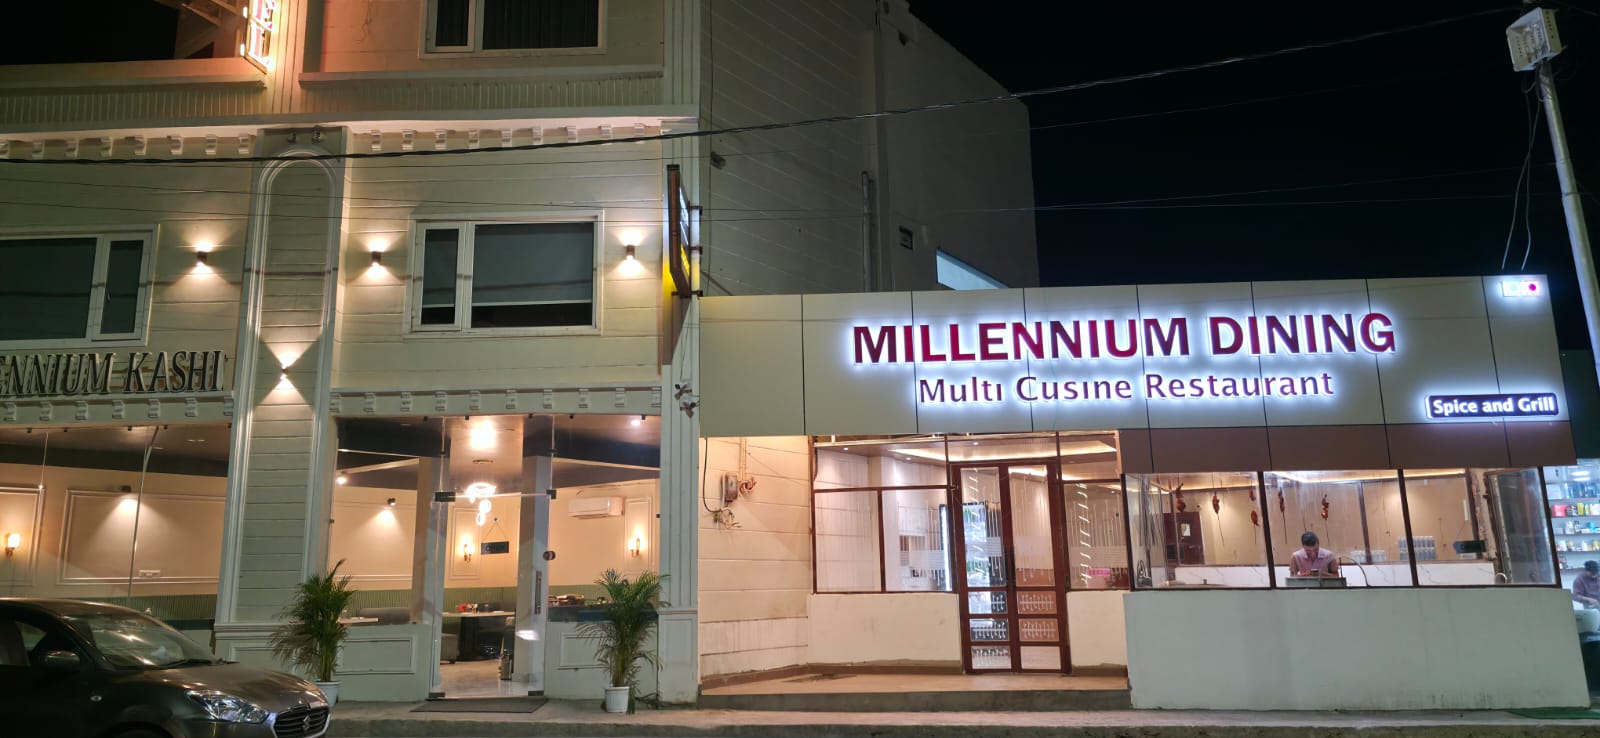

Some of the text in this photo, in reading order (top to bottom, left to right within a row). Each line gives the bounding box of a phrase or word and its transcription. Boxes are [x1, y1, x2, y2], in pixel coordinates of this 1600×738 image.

[853, 312, 1396, 364] MILLENNIUM DINING
[125, 350, 222, 392] KASHI
[1145, 372, 1334, 398] Restaurant
[1433, 396, 1555, 416] Spice and Grill
